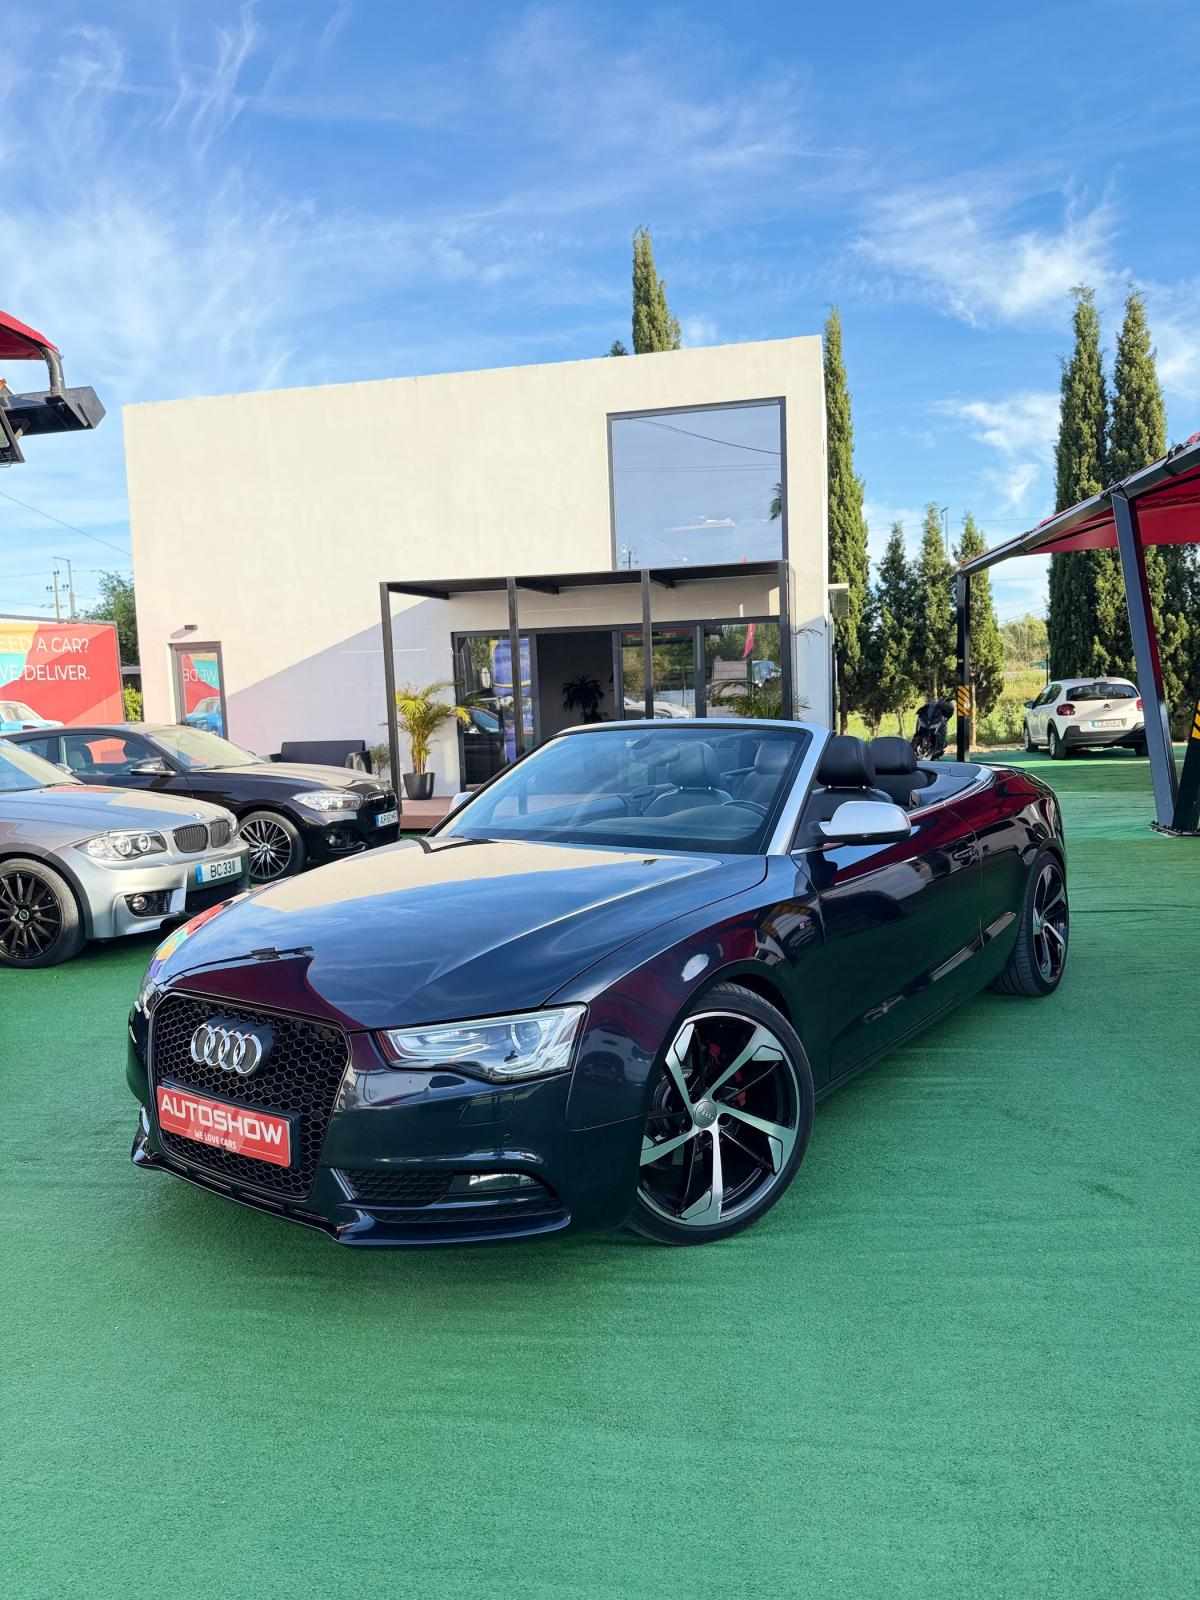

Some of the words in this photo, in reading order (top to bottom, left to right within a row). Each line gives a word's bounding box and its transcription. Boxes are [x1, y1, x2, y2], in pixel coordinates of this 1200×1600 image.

[36, 638, 48, 653] A
[50, 637, 89, 653] CAR?
[24, 664, 90, 681] DELIVER.
[161, 1094, 283, 1145] AUTOSHOW
[204, 1133, 220, 1145] LOVE
